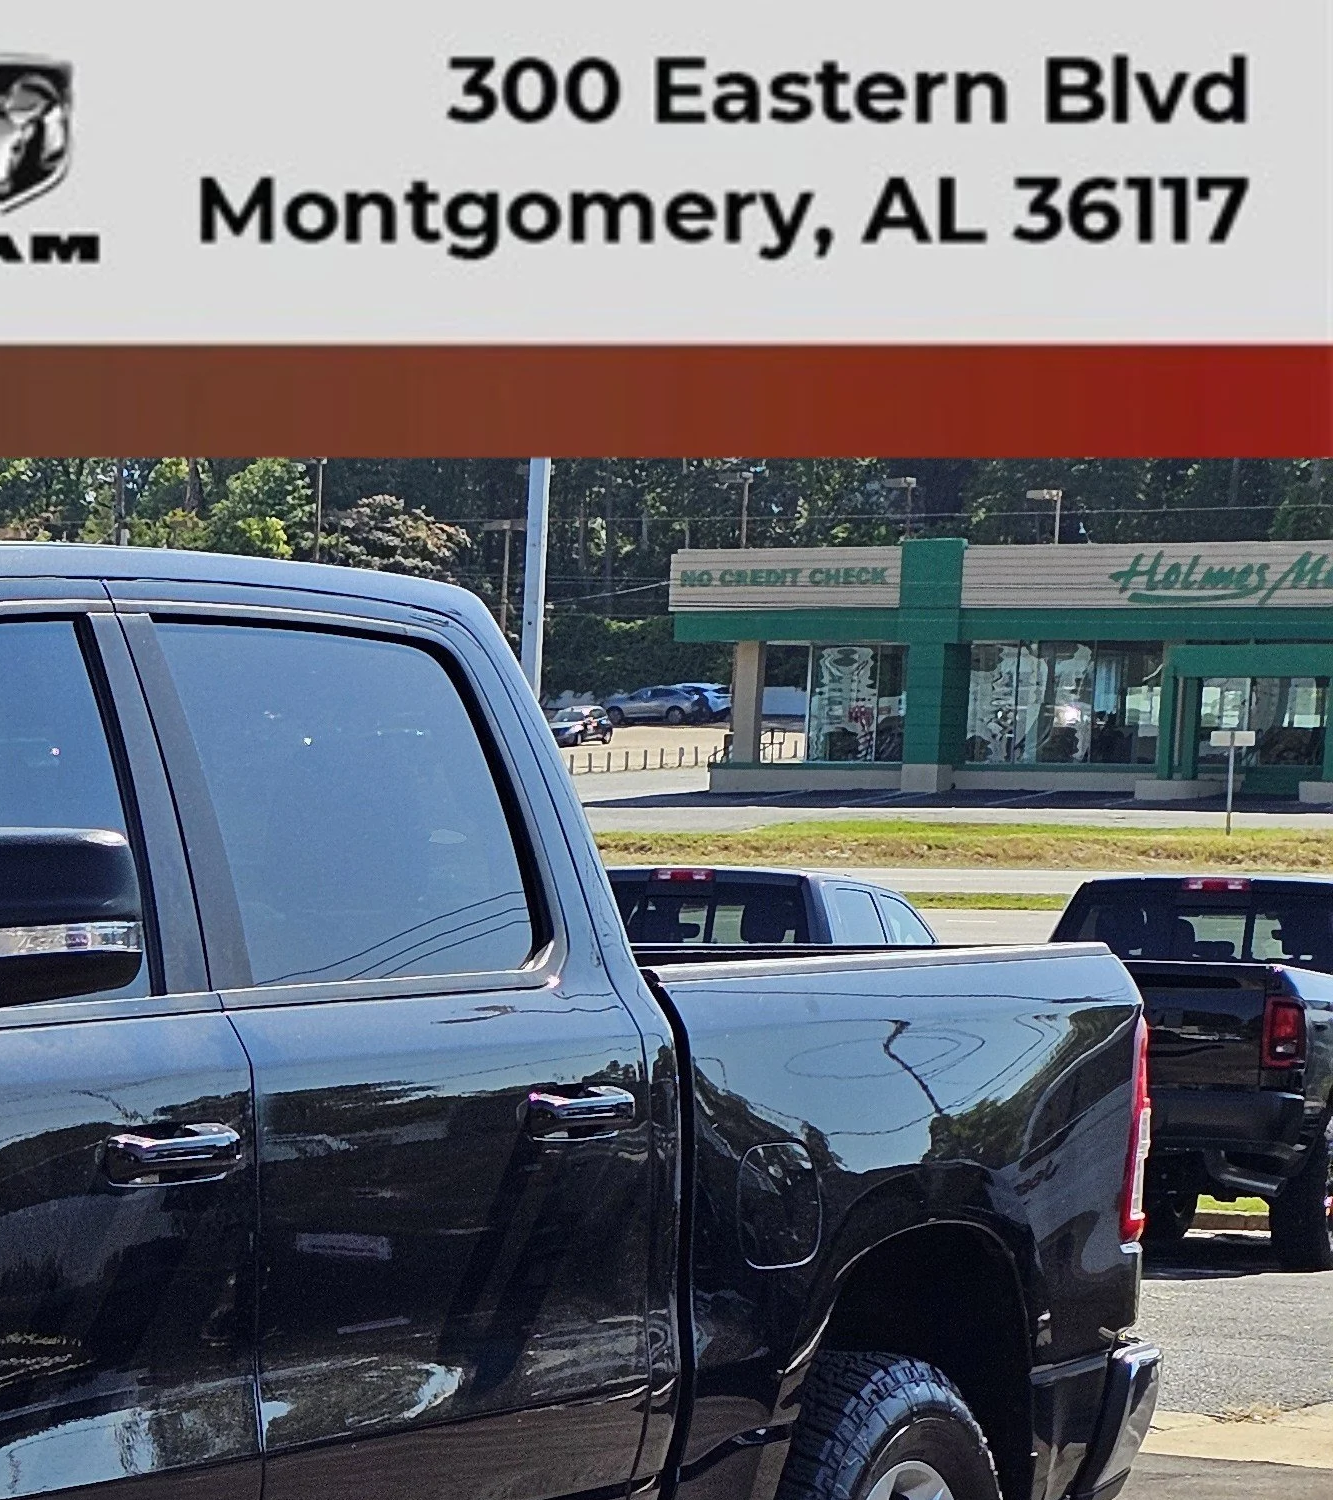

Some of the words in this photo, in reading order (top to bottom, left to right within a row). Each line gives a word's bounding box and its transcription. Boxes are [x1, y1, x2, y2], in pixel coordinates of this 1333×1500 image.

[680, 569, 713, 587] NO
[719, 568, 803, 587] CREDIT
[808, 566, 888, 586] CHECK
[1108, 550, 1271, 597] Holmes
